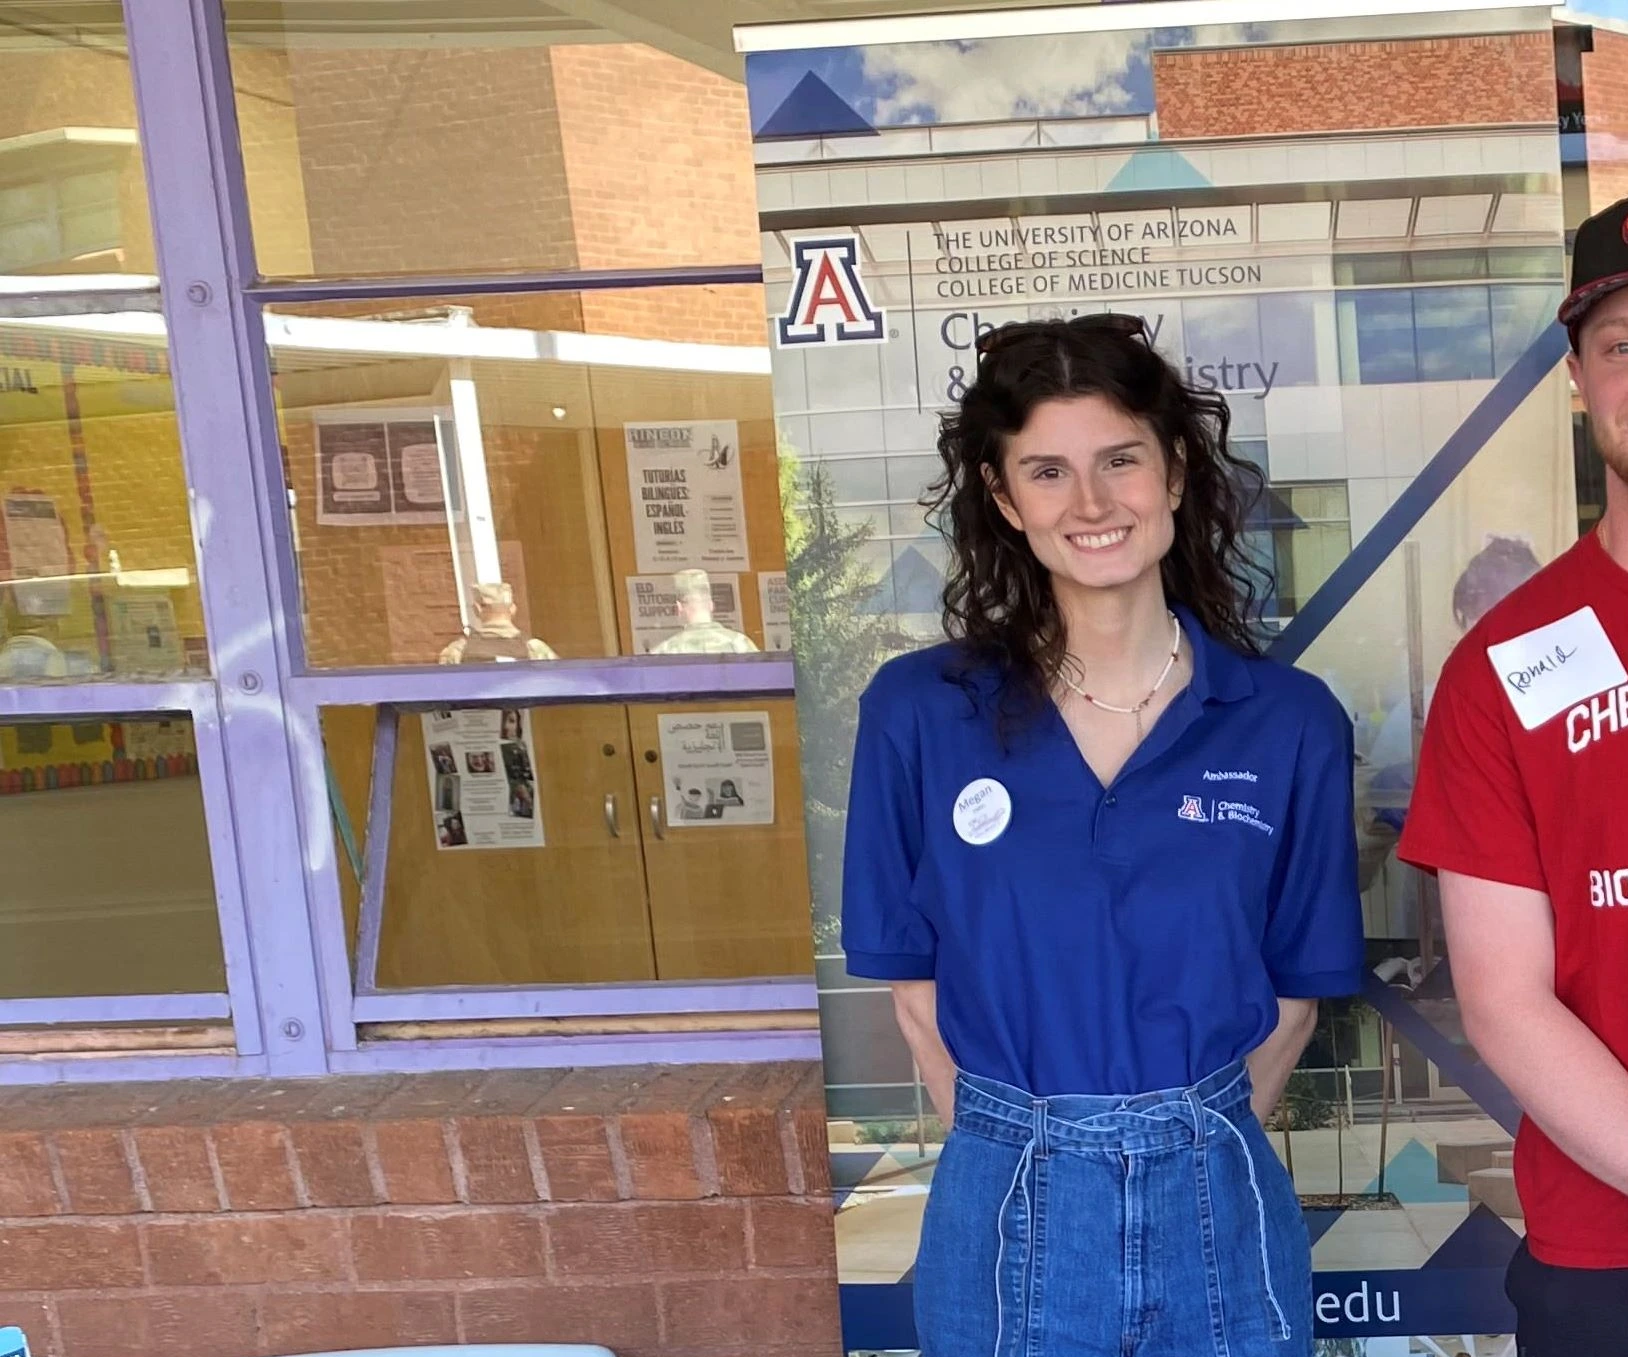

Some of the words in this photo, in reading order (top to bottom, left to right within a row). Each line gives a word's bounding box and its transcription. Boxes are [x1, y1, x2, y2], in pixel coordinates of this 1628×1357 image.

[934, 231, 973, 251] THE
[980, 226, 1099, 249] UNIVERSITY
[1109, 223, 1136, 242] OF
[1141, 218, 1238, 241] ARIZONA
[935, 250, 1025, 275] COLLEGE
[1031, 250, 1059, 269] OF
[1065, 246, 1151, 267] SCIENCE
[936, 276, 1025, 299] COLLEGE
[1033, 274, 1060, 294] OF
[1068, 269, 1170, 292] MEDICINE
[1176, 264, 1262, 287] TUCSON
[1203, 769, 1258, 783] Ambassador
[1218, 800, 1261, 819] Chemistry
